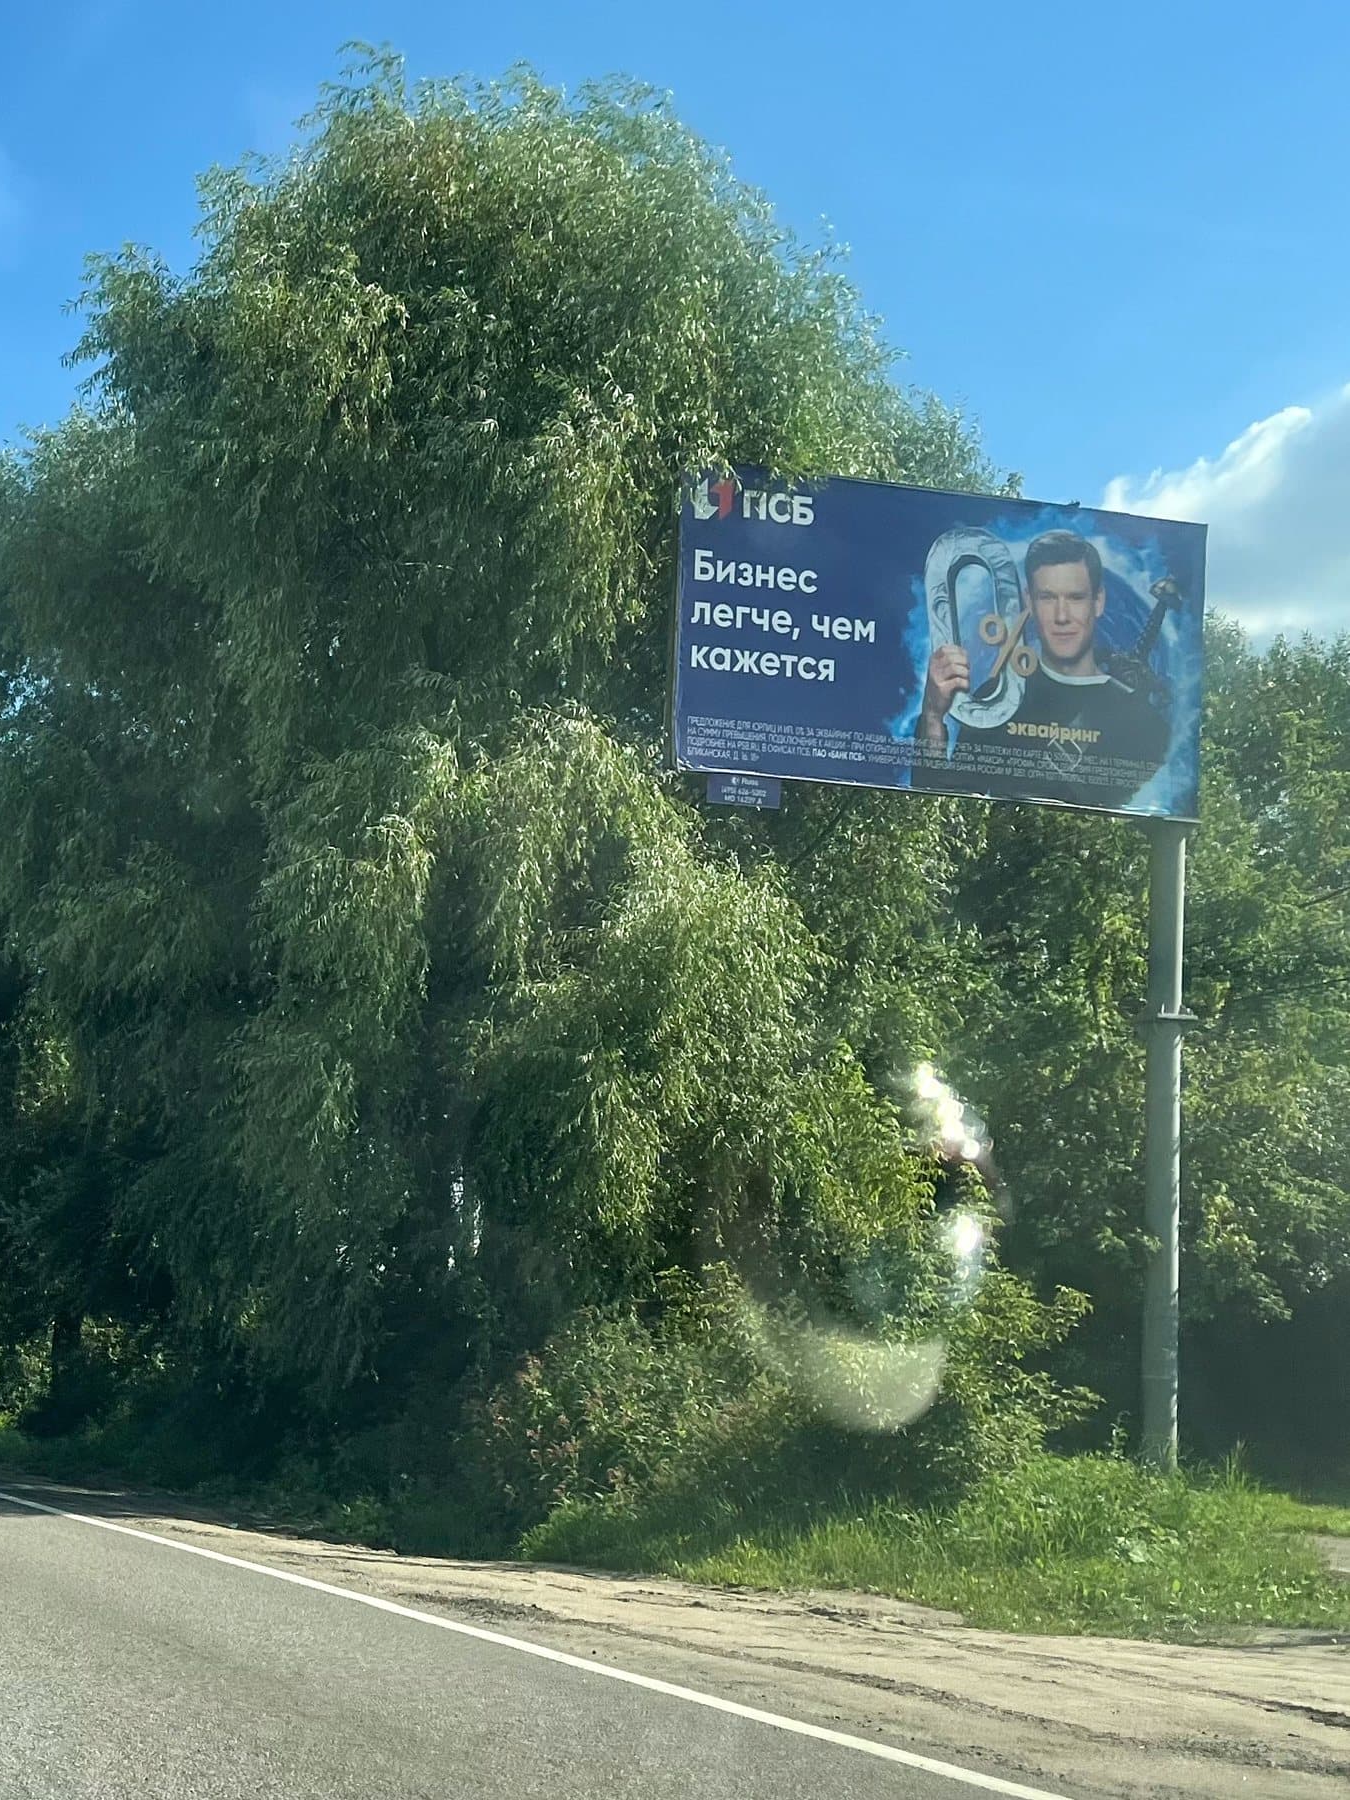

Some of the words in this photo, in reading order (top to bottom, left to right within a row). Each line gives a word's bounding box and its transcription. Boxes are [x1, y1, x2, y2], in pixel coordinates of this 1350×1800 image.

[742, 489, 815, 525] ПСБ
[693, 549, 818, 594] Бизнес
[690, 601, 800, 641] легче,
[811, 614, 876, 643] чем
[690, 645, 835, 682] кажется
[854, 733, 863, 741] ПО
[1007, 721, 1101, 744] эквайринг
[813, 749, 826, 758] ПАО
[828, 751, 848, 760] «БАНК
